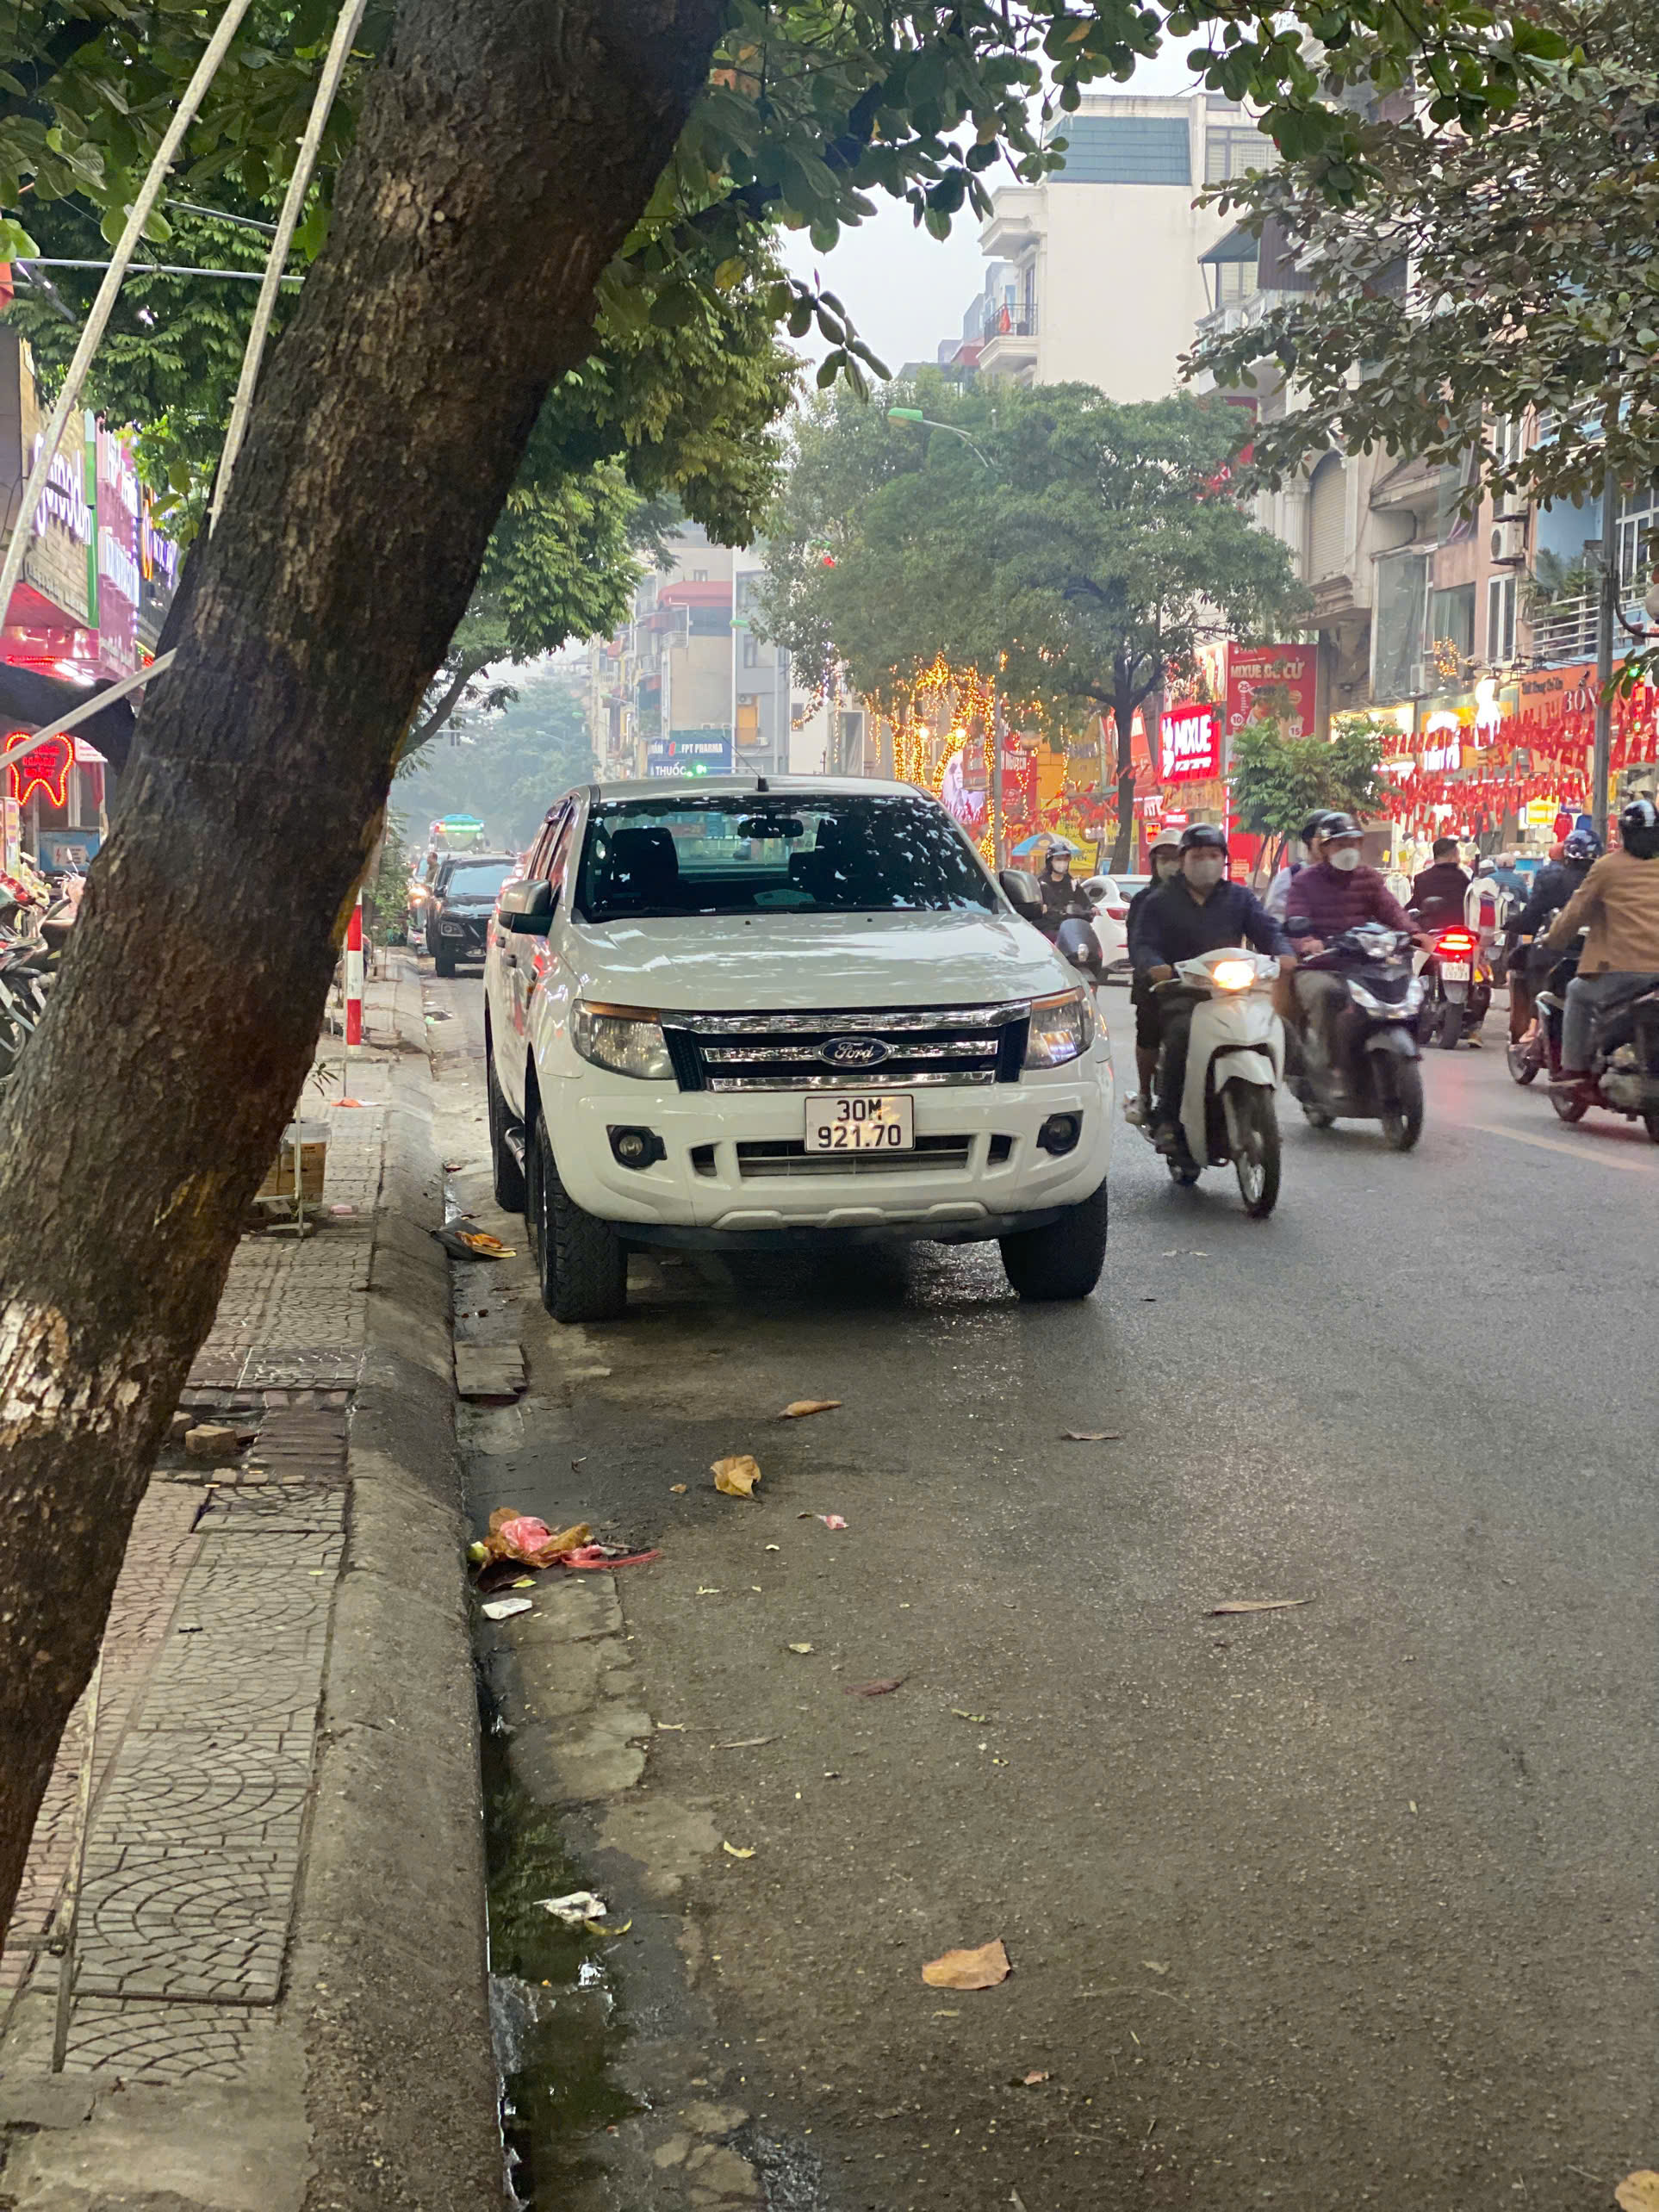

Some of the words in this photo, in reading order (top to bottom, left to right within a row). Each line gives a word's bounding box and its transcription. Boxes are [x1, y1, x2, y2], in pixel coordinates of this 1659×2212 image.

[1230, 664, 1262, 678] MIXUE
[1239, 683, 1249, 692] 25
[1232, 715, 1242, 724] 10
[1174, 714, 1212, 756] MIXUE
[655, 761, 687, 776] THUỐC
[834, 1041, 874, 1059] Ford
[836, 1098, 883, 1122] 30M
[818, 1124, 901, 1147] 921.70
